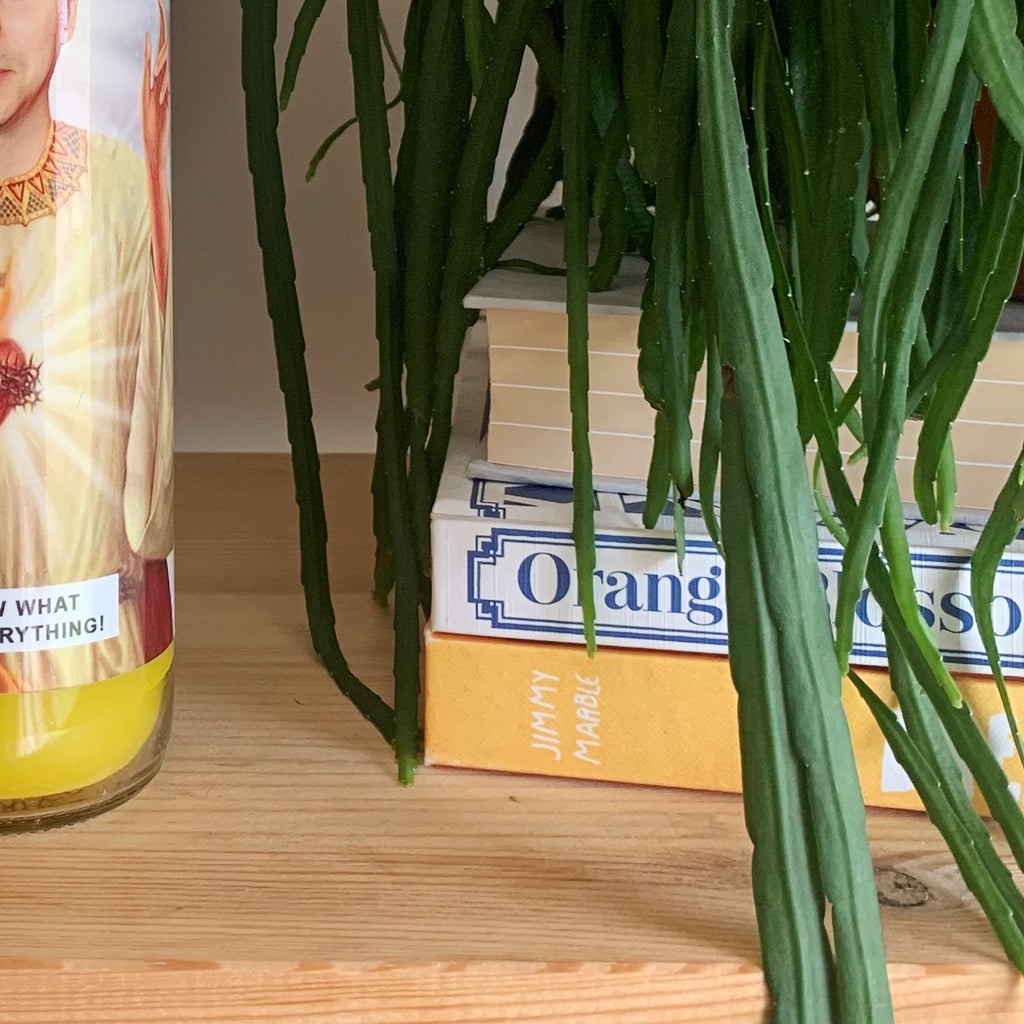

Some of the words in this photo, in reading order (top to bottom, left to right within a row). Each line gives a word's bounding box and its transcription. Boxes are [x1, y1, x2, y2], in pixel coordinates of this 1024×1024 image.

[15, 593, 81, 616] WHAT
[529, 669, 561, 762] JIMMY
[572, 672, 602, 766] MARBLE
